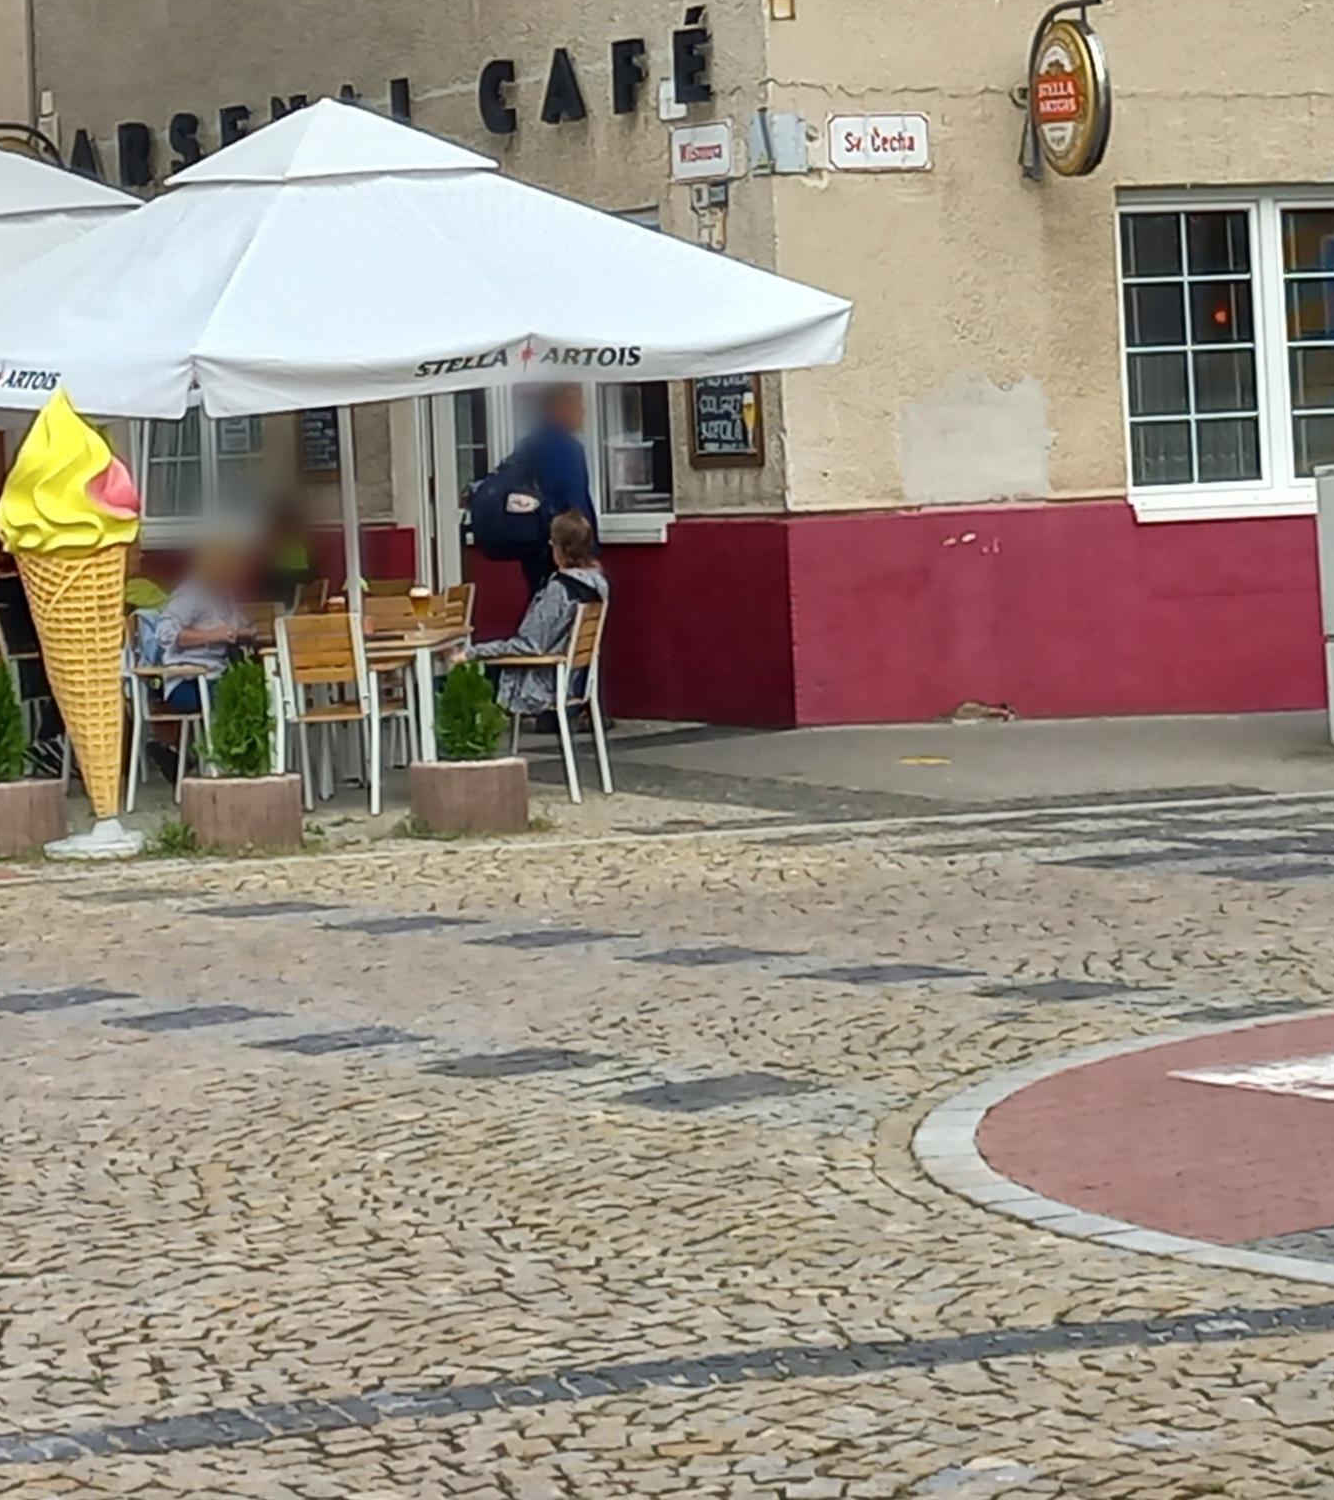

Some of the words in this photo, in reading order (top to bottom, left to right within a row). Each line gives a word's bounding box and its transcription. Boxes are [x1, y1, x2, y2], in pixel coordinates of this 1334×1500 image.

[478, 3, 712, 135] CAFÉ
[870, 126, 916, 152] Čecha
[414, 348, 509, 378] STELLA
[540, 346, 642, 367] ARTOIS
[1, 369, 62, 392] ARTOIS
